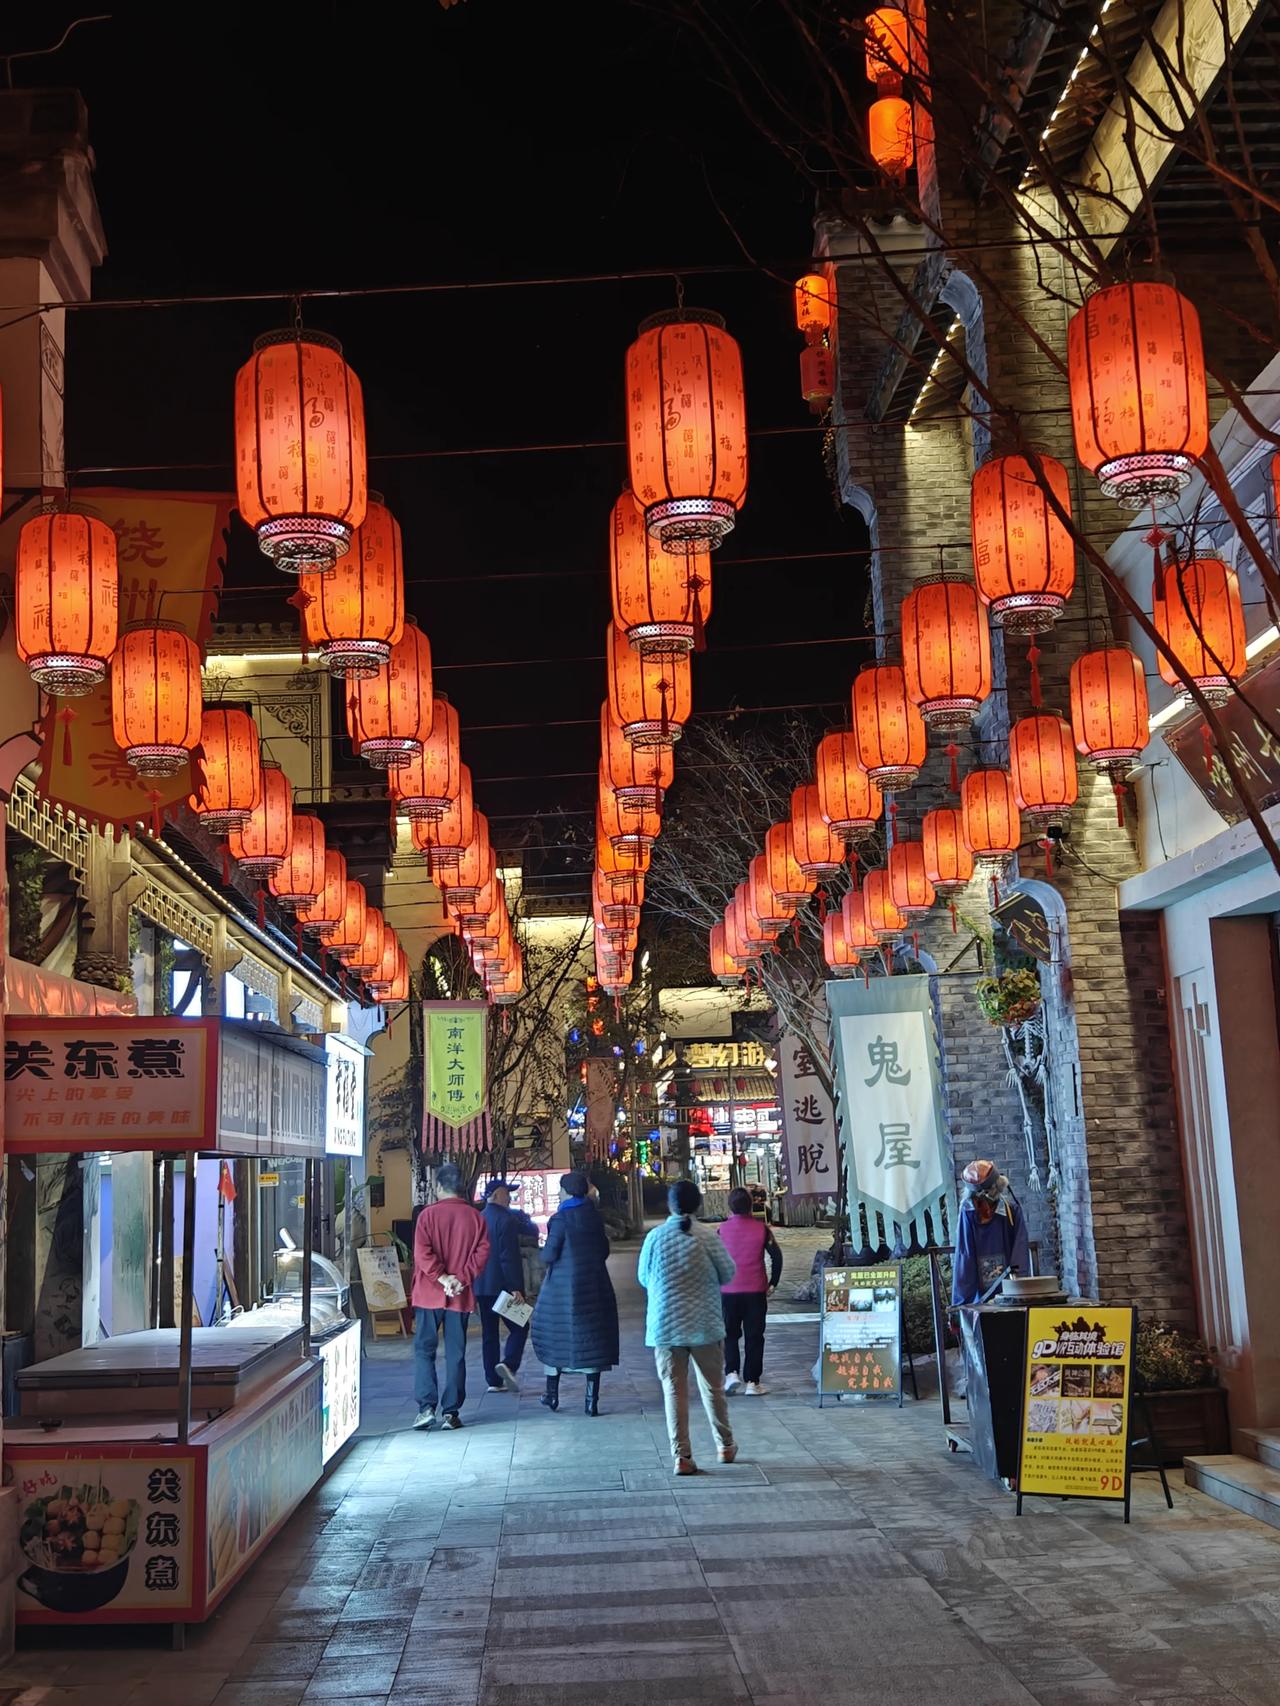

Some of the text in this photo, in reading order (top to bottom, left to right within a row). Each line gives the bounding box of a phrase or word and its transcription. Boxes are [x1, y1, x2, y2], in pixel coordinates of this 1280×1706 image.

[5, 1039, 186, 1080] 关东煮
[15, 1086, 135, 1101] 尖上的享受
[864, 1034, 921, 1171] 鬼屋
[23, 1109, 192, 1128] 不可抗拒的美味
[22, 1471, 58, 1495] 好吃
[145, 1467, 182, 1592] 关东煮
